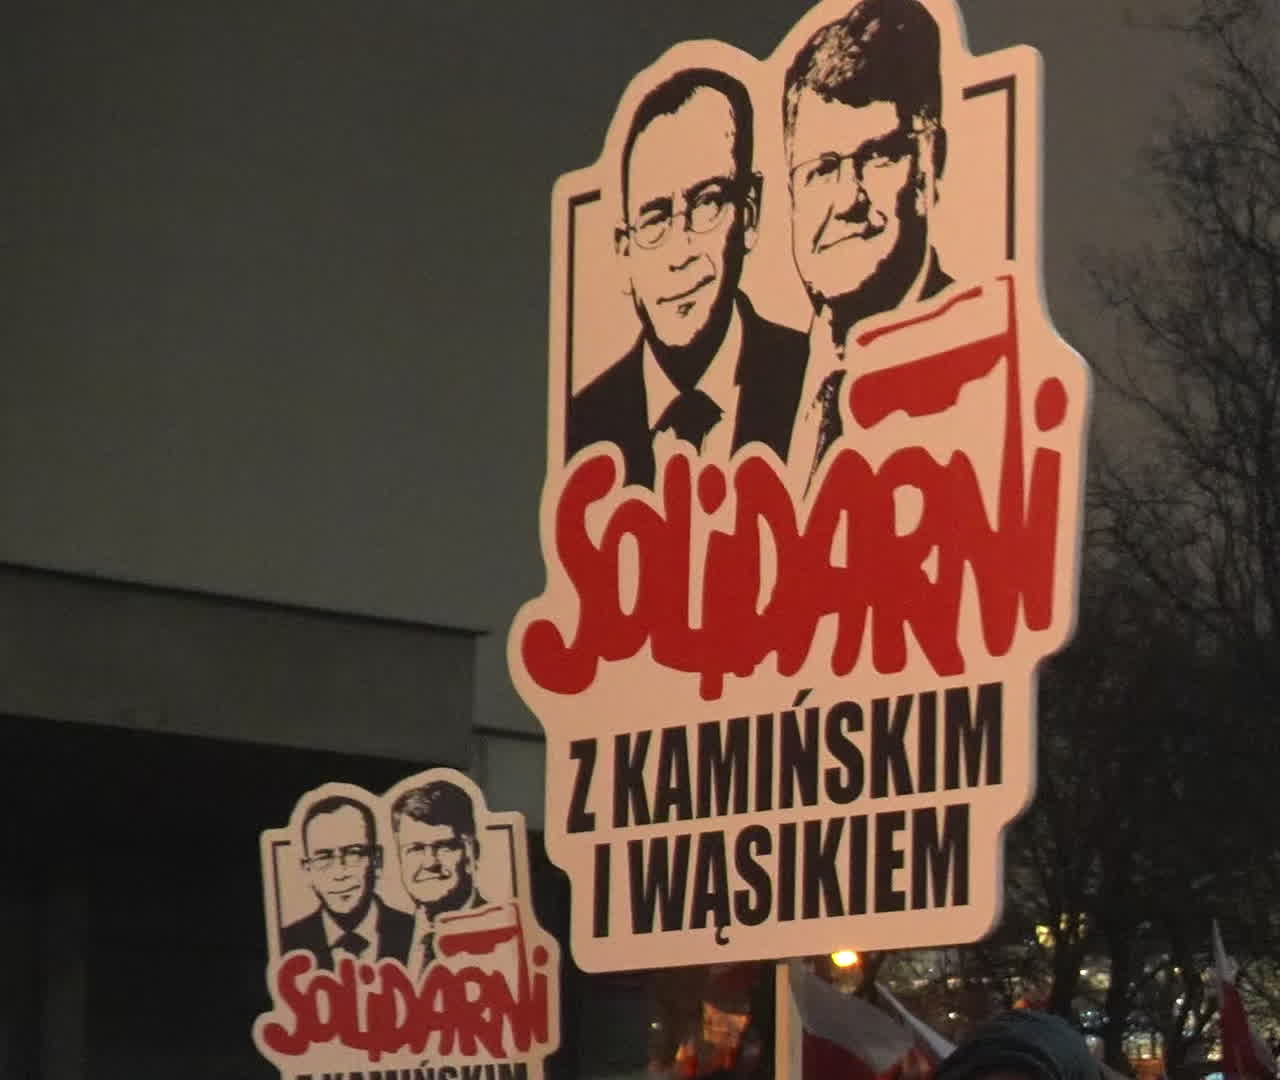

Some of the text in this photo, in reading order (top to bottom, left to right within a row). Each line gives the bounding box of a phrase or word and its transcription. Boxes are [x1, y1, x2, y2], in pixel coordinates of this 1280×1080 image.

[565, 682, 1003, 834] Z KAMIŃSKIM
[592, 803, 970, 946] I WĄSIKIEM
